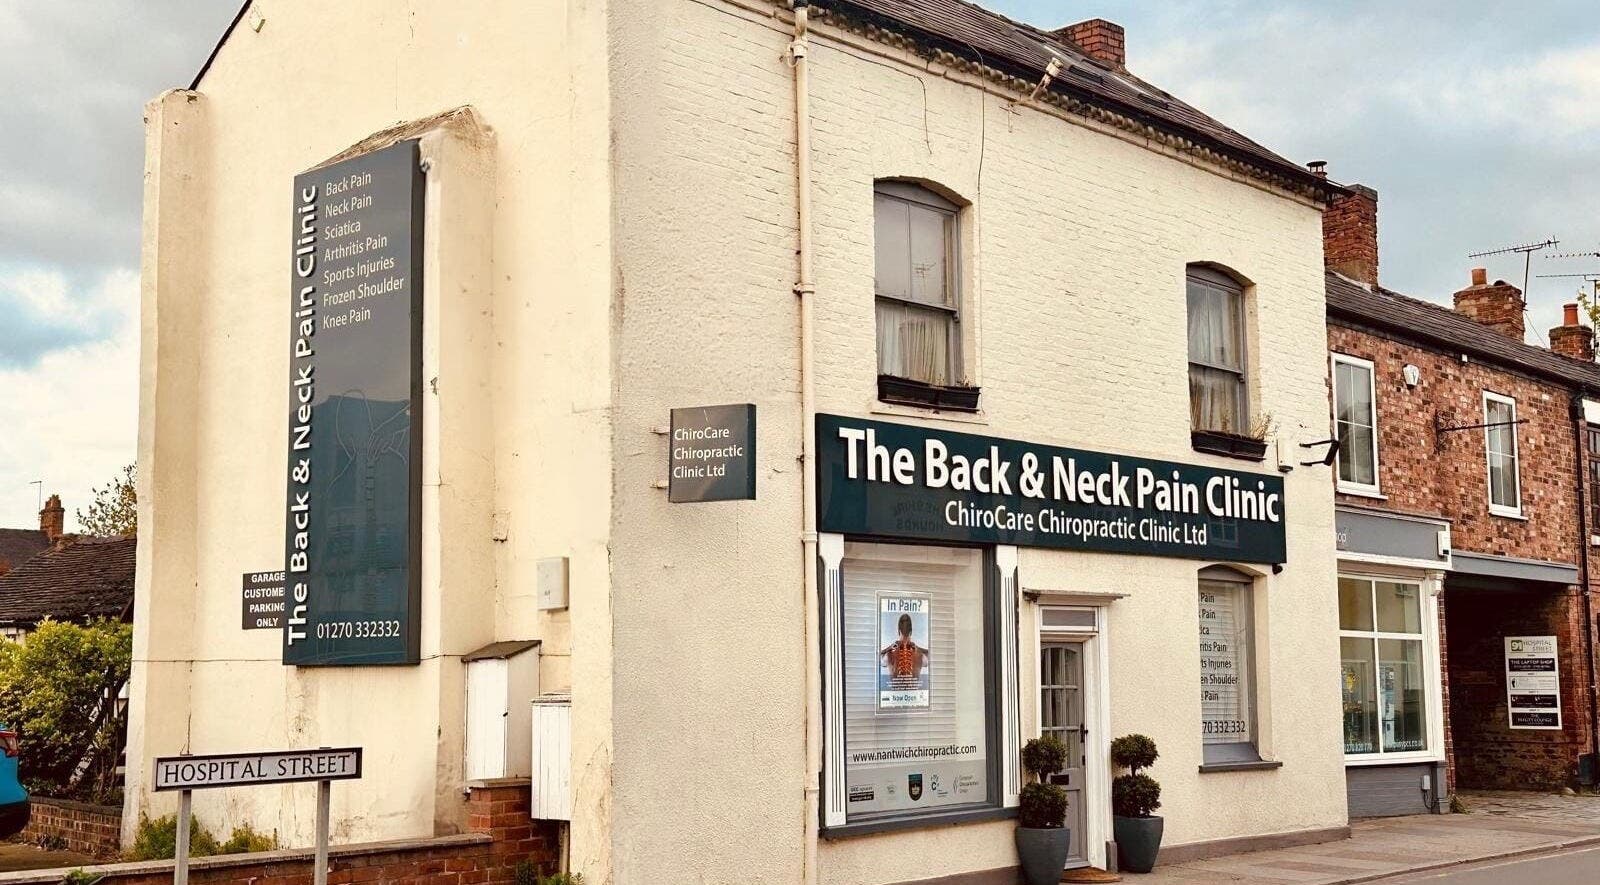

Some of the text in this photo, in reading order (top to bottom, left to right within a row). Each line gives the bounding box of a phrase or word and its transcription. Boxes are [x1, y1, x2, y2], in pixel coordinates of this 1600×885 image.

[326, 172, 372, 196] Back Pain
[325, 194, 372, 218] Neck Pain
[324, 220, 361, 240] Sciatica
[324, 234, 388, 262] Arthritis Pain
[324, 256, 394, 286] Sports Injuries
[323, 278, 404, 308] Frozen Shoulder
[322, 308, 370, 329] Knee Pain
[288, 185, 316, 644] The Back & Neck Pain Clinic
[674, 427, 730, 440] ChiroCare
[674, 444, 743, 461] Chiropractic
[673, 464, 725, 478] Clinic Ltd
[838, 427, 1280, 522] The Back & Neck Pain Clinic
[945, 500, 1034, 531] ChiroCare
[1038, 508, 1136, 542] Chiropractic
[1140, 518, 1180, 544] Clinic
[1184, 522, 1207, 546] Ltd
[251, 572, 286, 582] GARAGE
[244, 587, 286, 598] CUSTOME
[1200, 593, 1214, 602] Pain
[888, 600, 922, 612] In Pain?
[1202, 609, 1216, 619] Pain
[256, 618, 278, 628] ONLY
[317, 620, 400, 639] 01270 332332
[1213, 642, 1226, 652] Pain
[1210, 674, 1238, 684] Shoulder
[1204, 690, 1218, 701] Pain
[1214, 721, 1229, 734] 332
[1231, 720, 1245, 732] 332
[852, 744, 976, 762] www.nantwichchiropractic.com
[164, 754, 350, 784] HOSPITAL STREET
